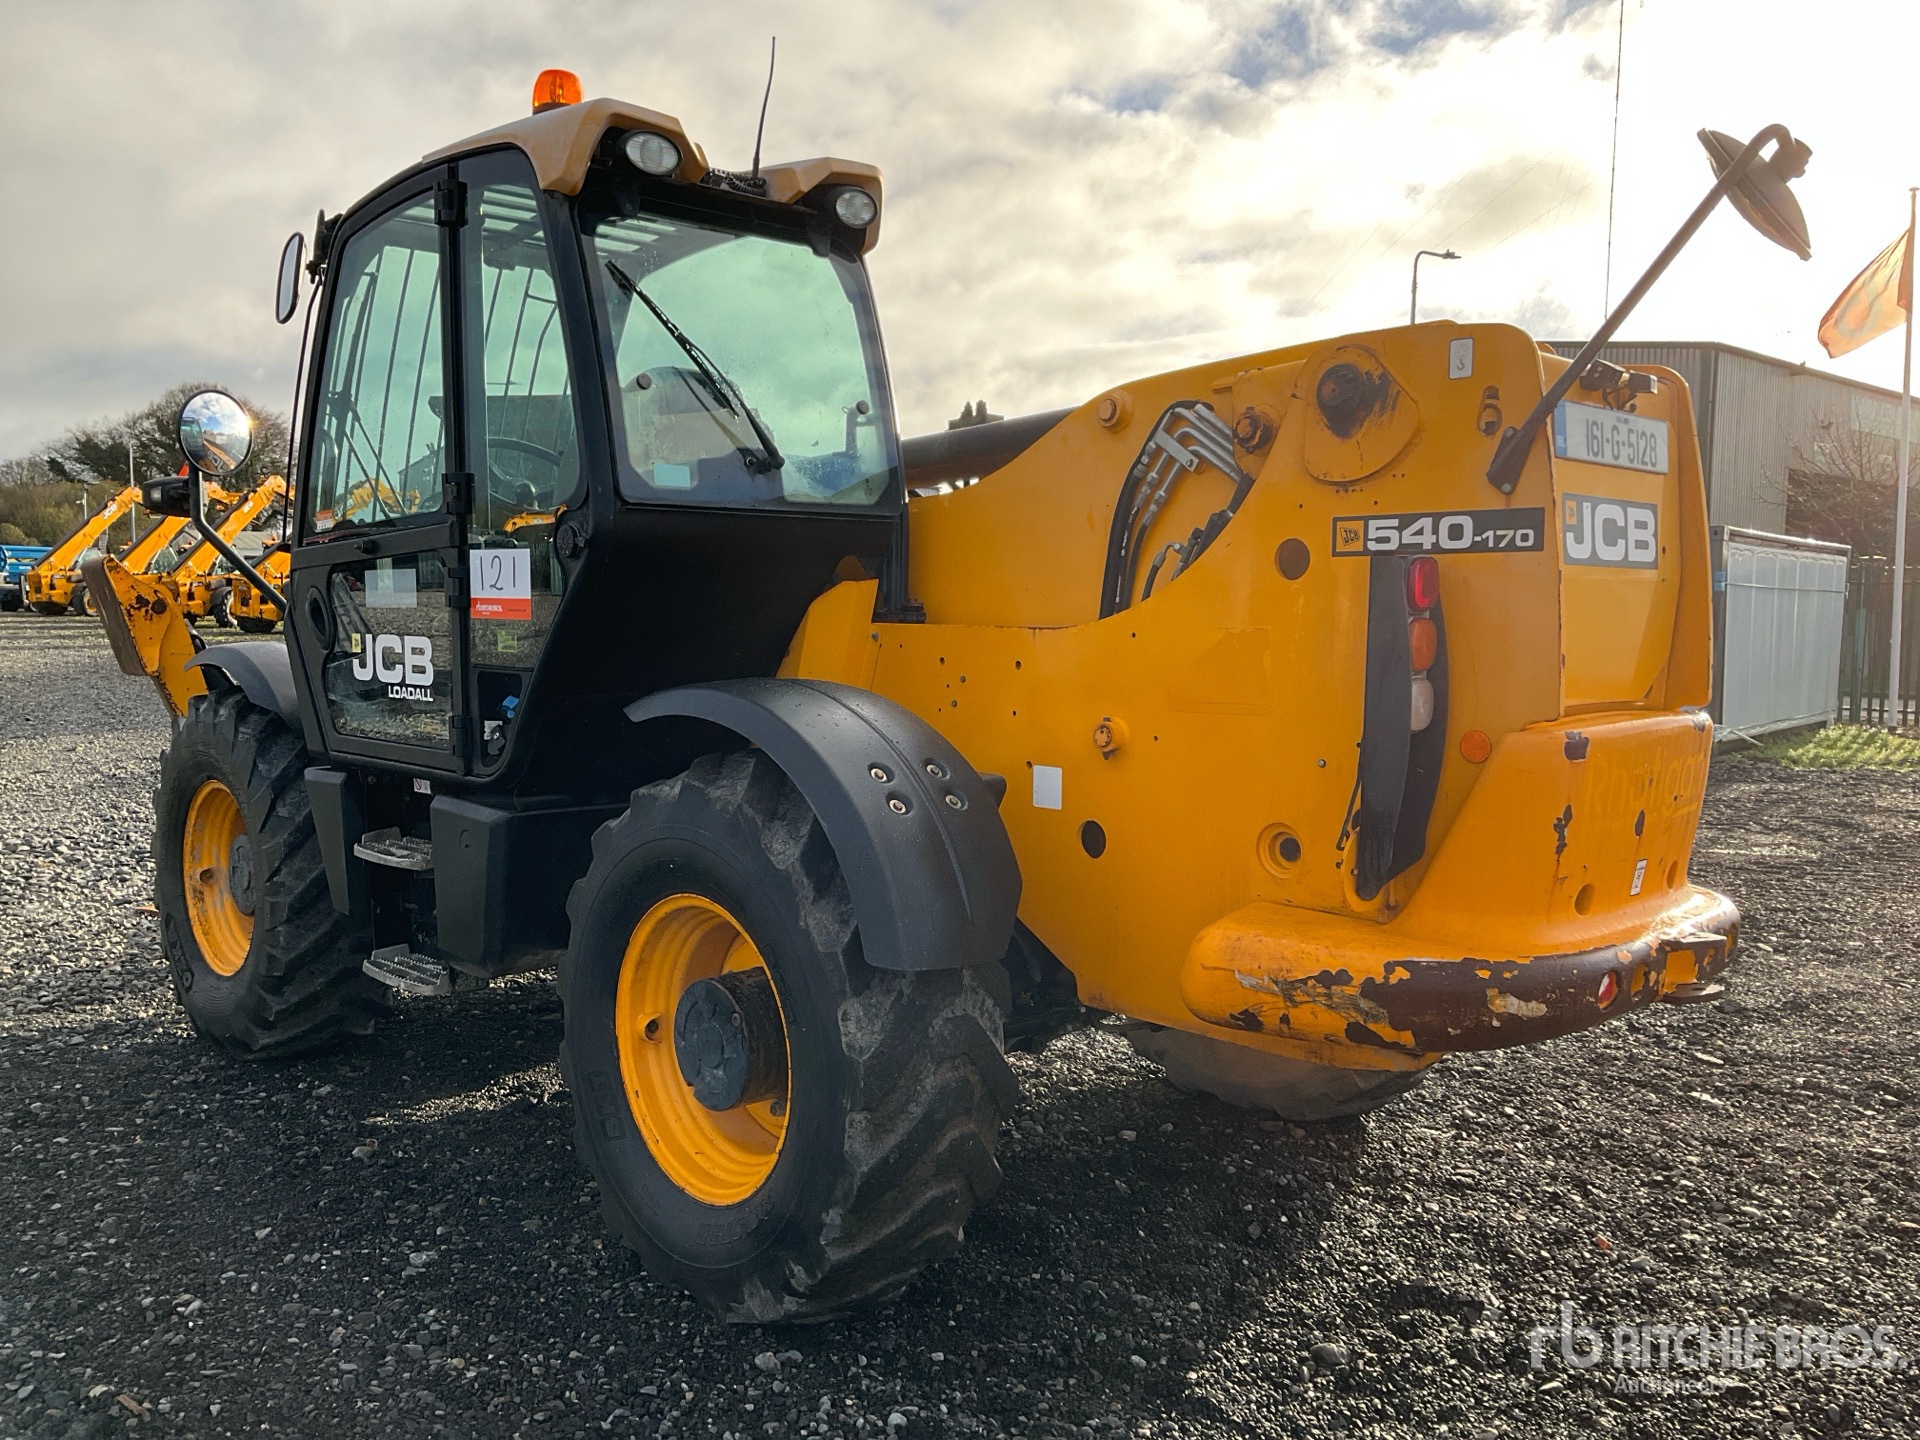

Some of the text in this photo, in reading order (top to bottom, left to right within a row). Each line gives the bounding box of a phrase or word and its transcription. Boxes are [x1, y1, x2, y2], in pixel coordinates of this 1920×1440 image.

[1586, 419, 1658, 468] 161-G-5128
[1367, 515, 1535, 551] 540-170
[1566, 502, 1656, 562] JCB
[480, 555, 516, 591] 121
[353, 634, 434, 686] JCB
[388, 685, 434, 702] LOADALL
